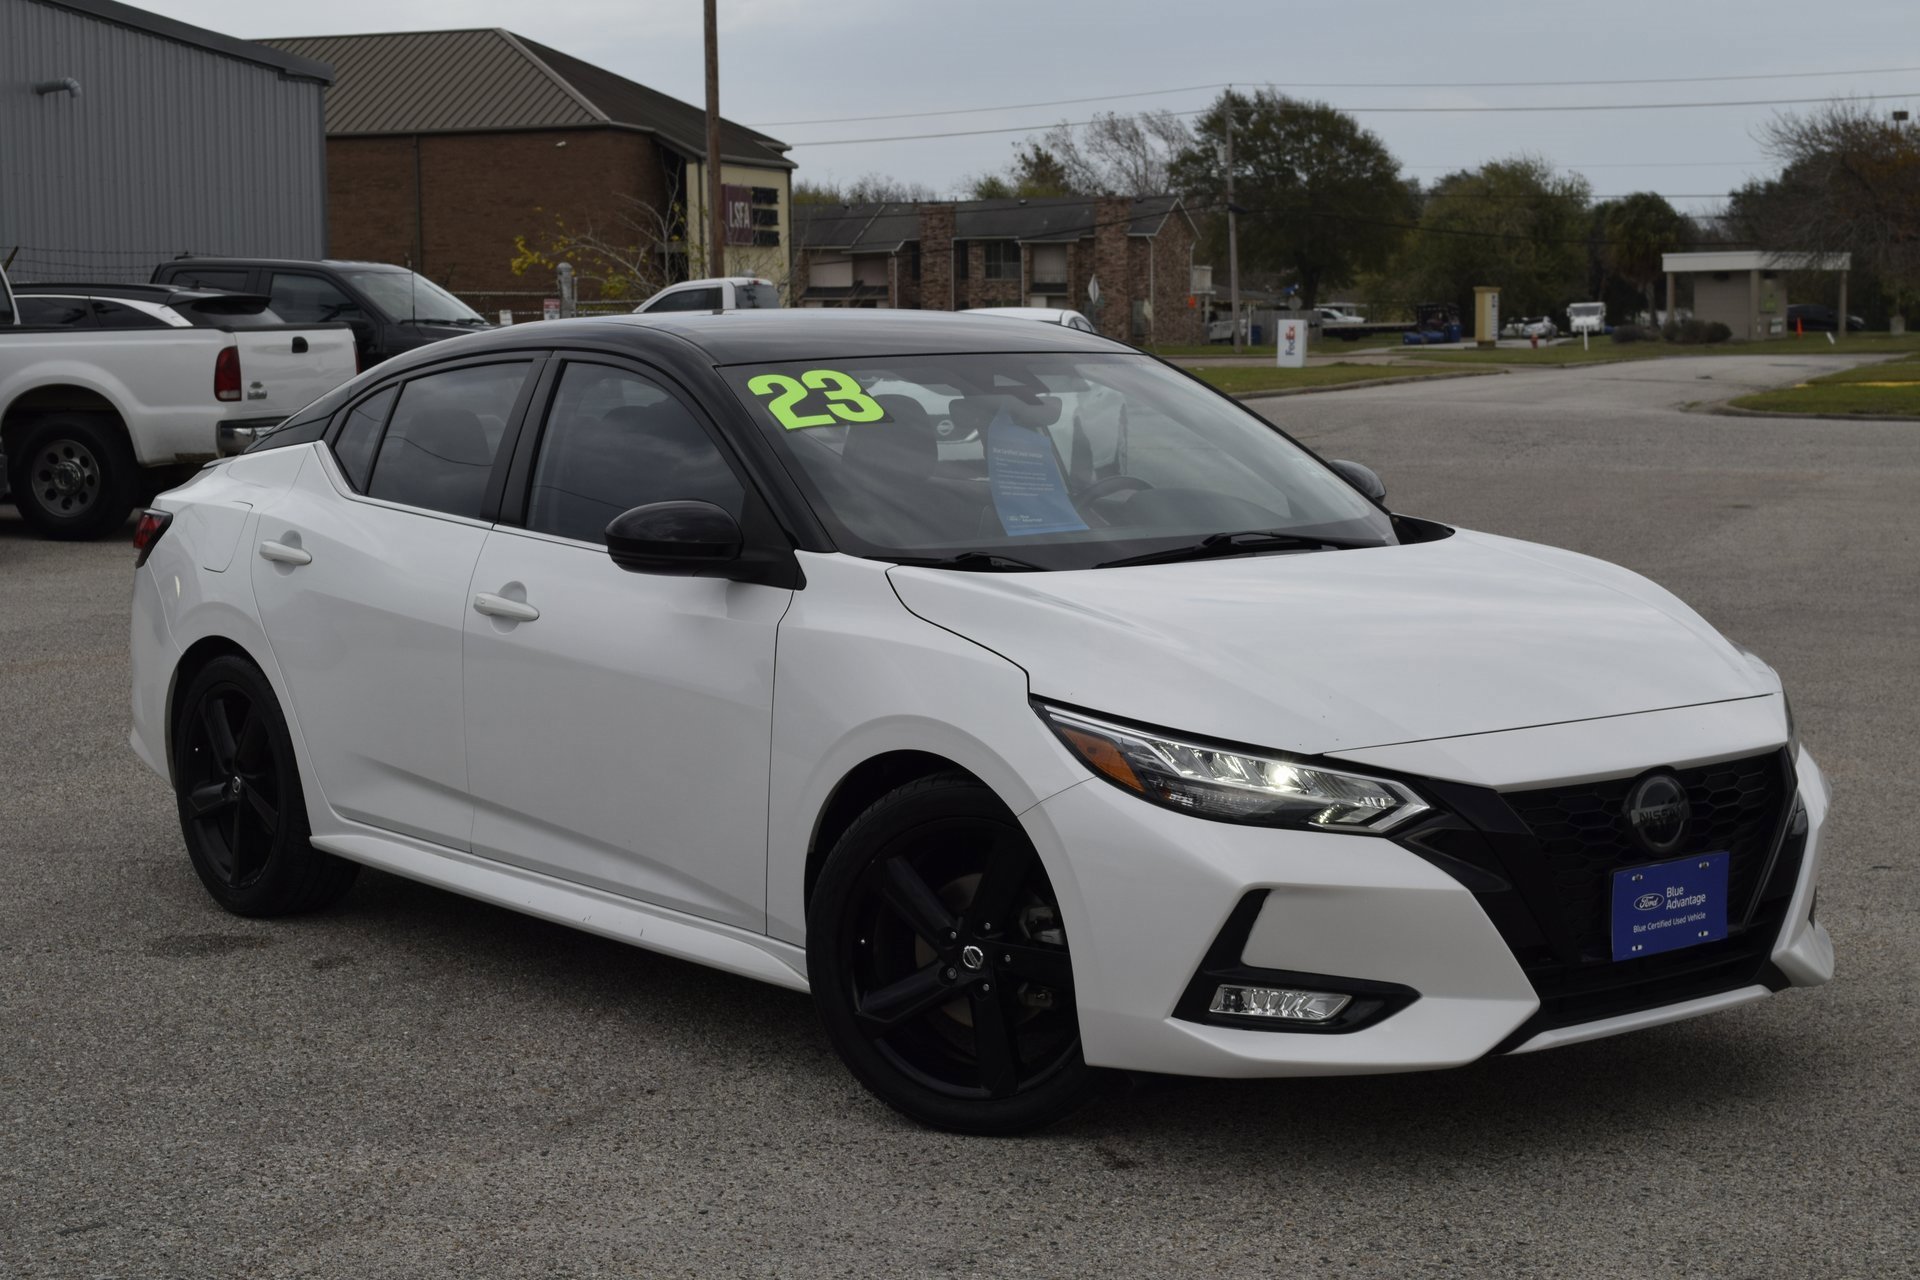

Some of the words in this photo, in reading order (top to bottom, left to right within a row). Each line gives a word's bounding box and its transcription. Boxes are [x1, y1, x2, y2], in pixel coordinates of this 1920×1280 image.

[1285, 326, 1295, 356] FedEx
[747, 369, 885, 431] 23
[1639, 895, 1659, 909] Ford
[1666, 886, 1684, 898] Blue
[1666, 893, 1706, 910] Advantage
[1633, 924, 1646, 934] Blue
[1647, 919, 1672, 931] Certified
[1673, 915, 1687, 926] Used
[1687, 911, 1706, 923] Vehicle
